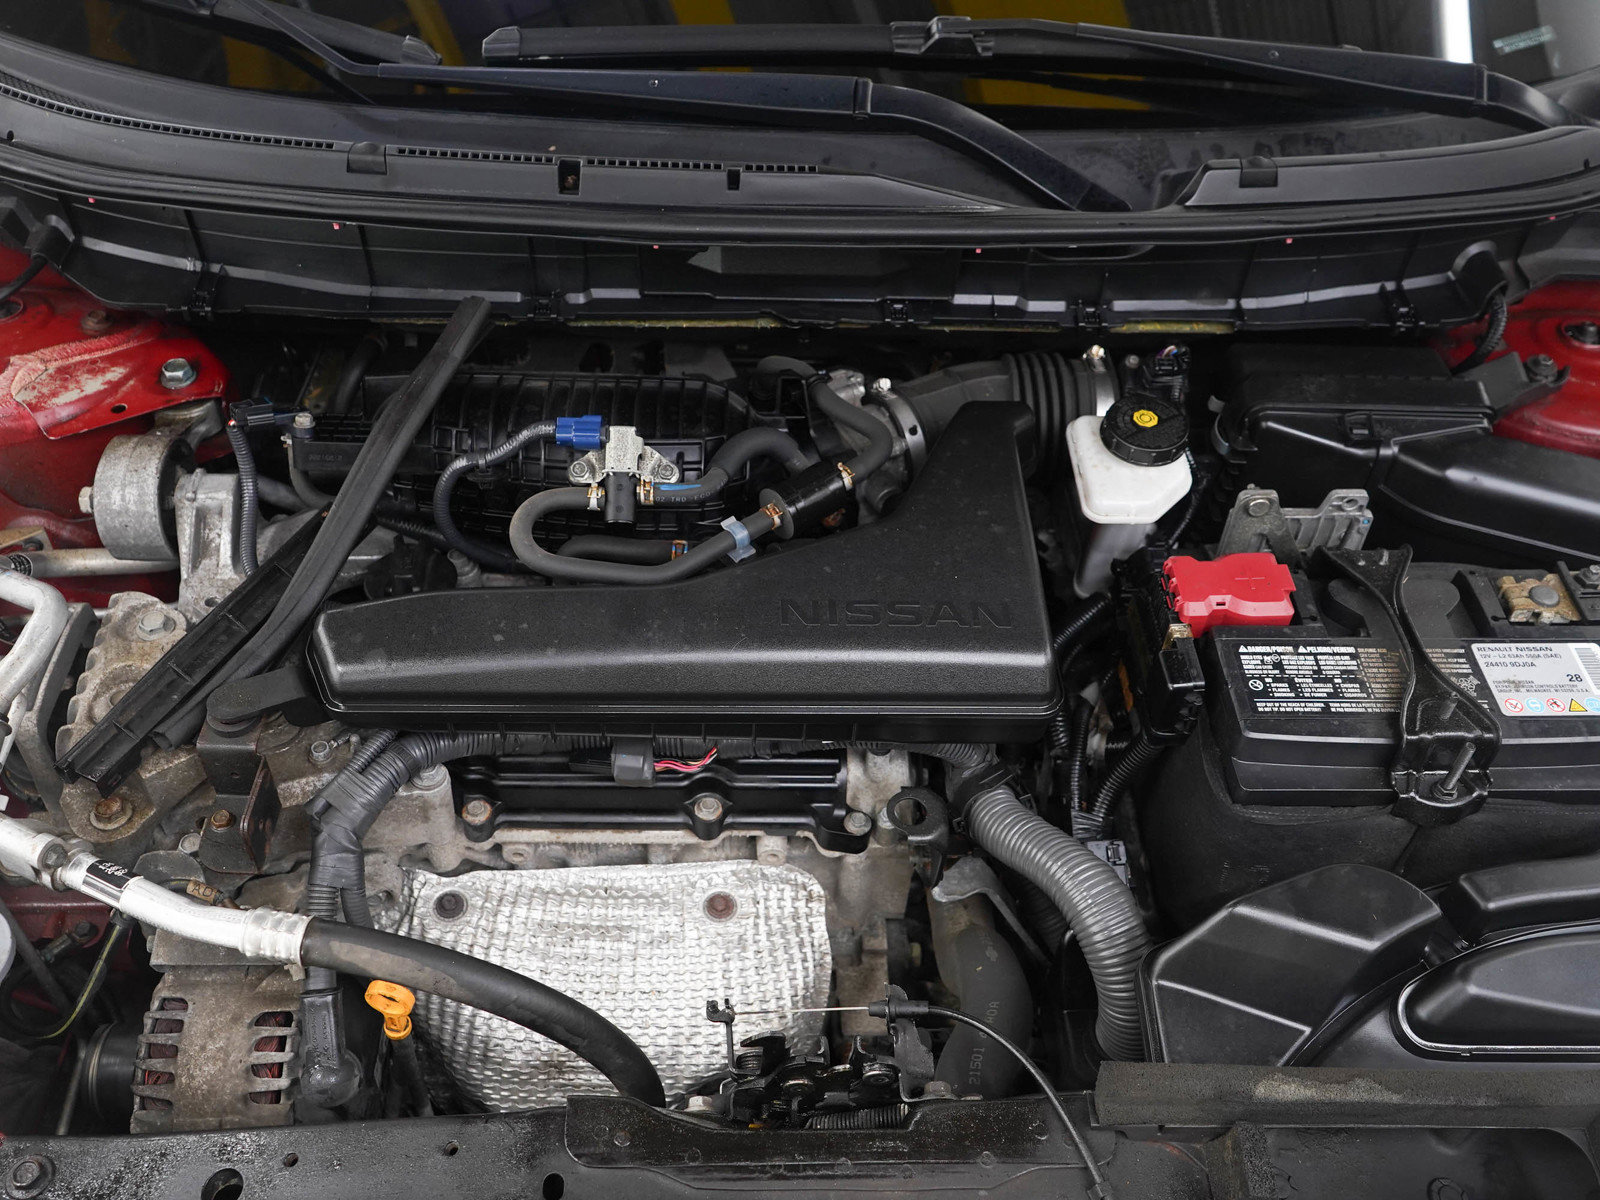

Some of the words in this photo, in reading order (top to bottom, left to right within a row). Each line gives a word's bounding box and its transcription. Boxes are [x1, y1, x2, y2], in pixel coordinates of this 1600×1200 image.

[780, 599, 1012, 629] NISSAN
[1566, 674, 1583, 682] 28
[968, 1047, 985, 1085] 21501
